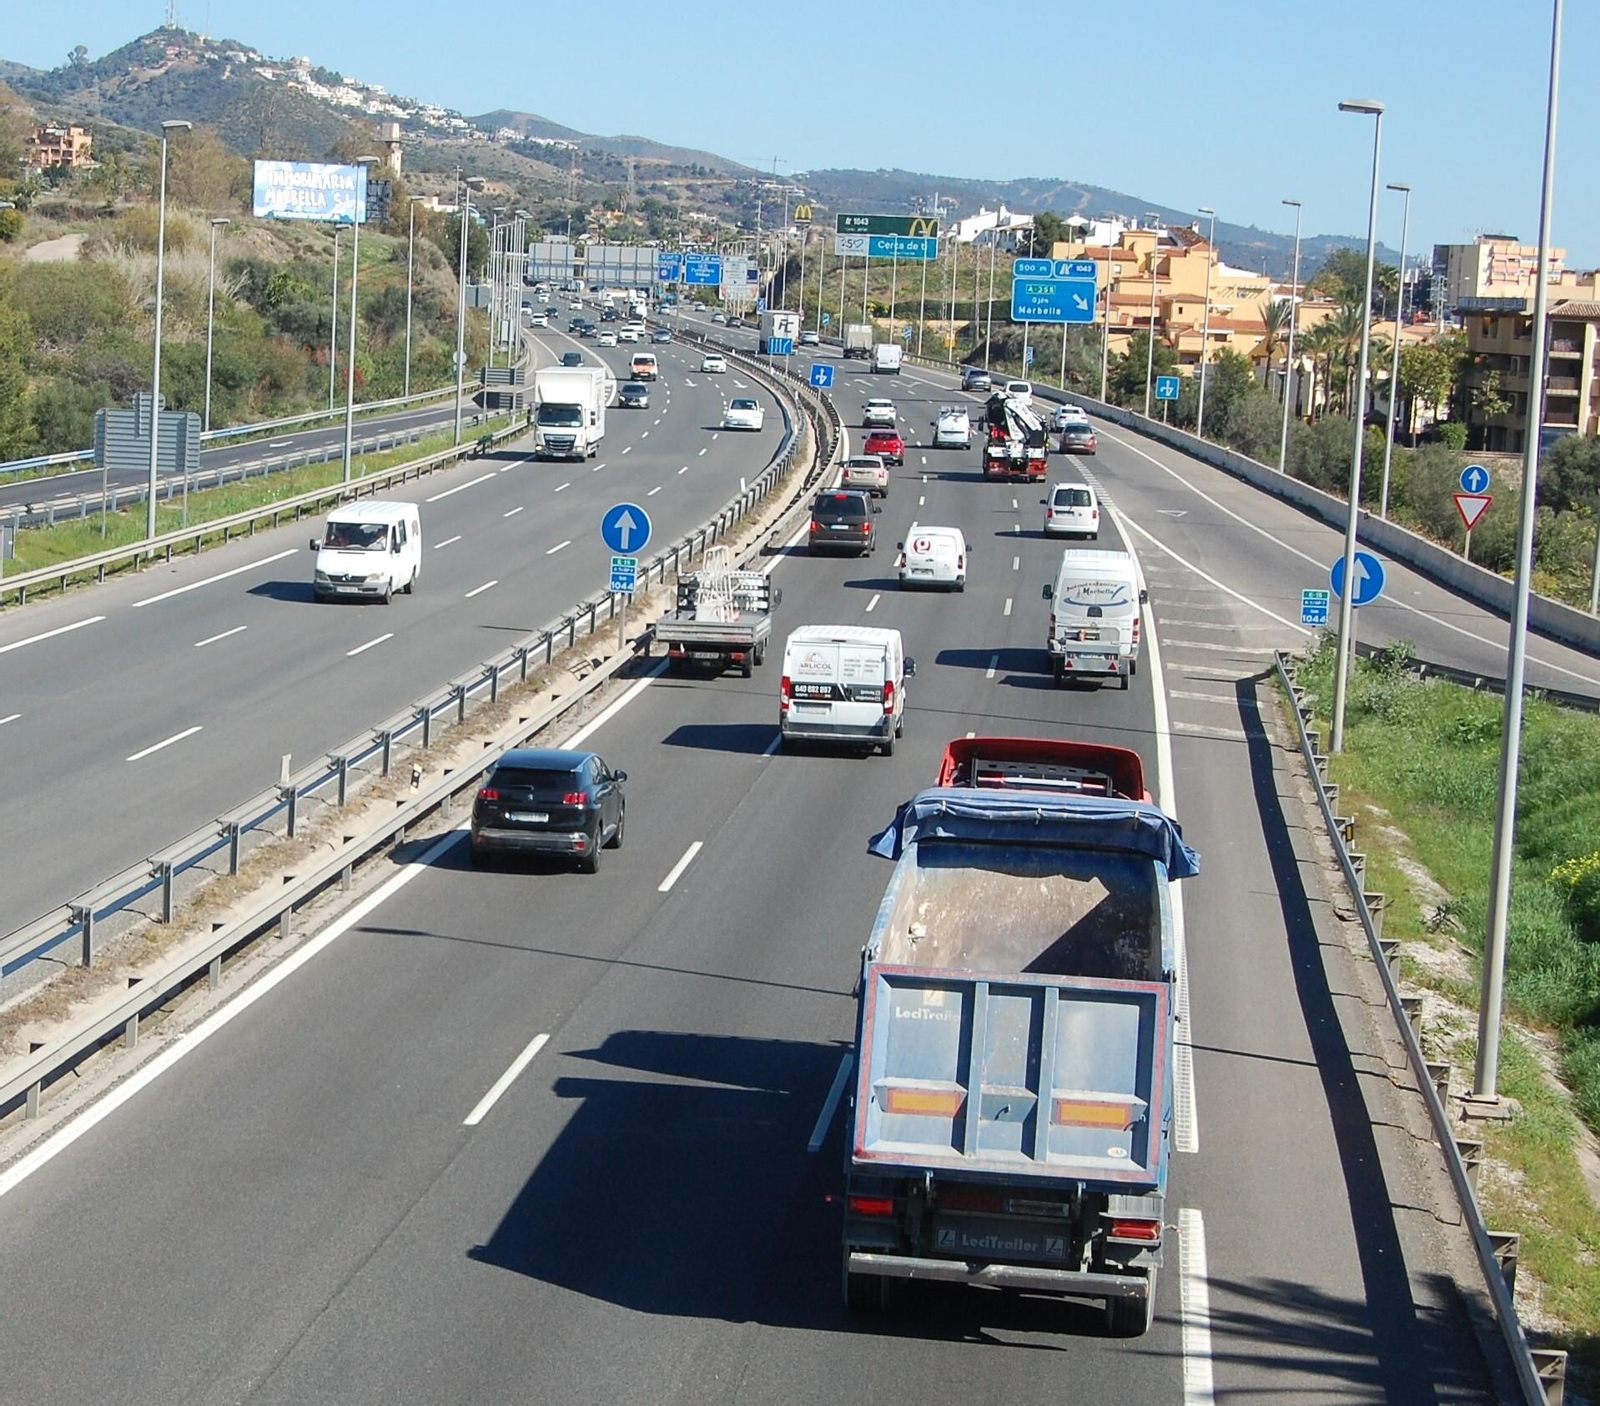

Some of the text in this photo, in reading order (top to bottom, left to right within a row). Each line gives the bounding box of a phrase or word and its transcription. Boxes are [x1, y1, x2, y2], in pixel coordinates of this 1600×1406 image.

[267, 170, 355, 190] INMOBILIARIA
[264, 188, 326, 207] MARBELLA
[877, 240, 904, 250] Cerca
[906, 241, 919, 251] de
[1019, 264, 1036, 272] 500
[1018, 305, 1062, 315] Marbella
[611, 581, 634, 590] 1044
[1302, 614, 1326, 623] 1044
[961, 1233, 1040, 1252] LeciTrailer
